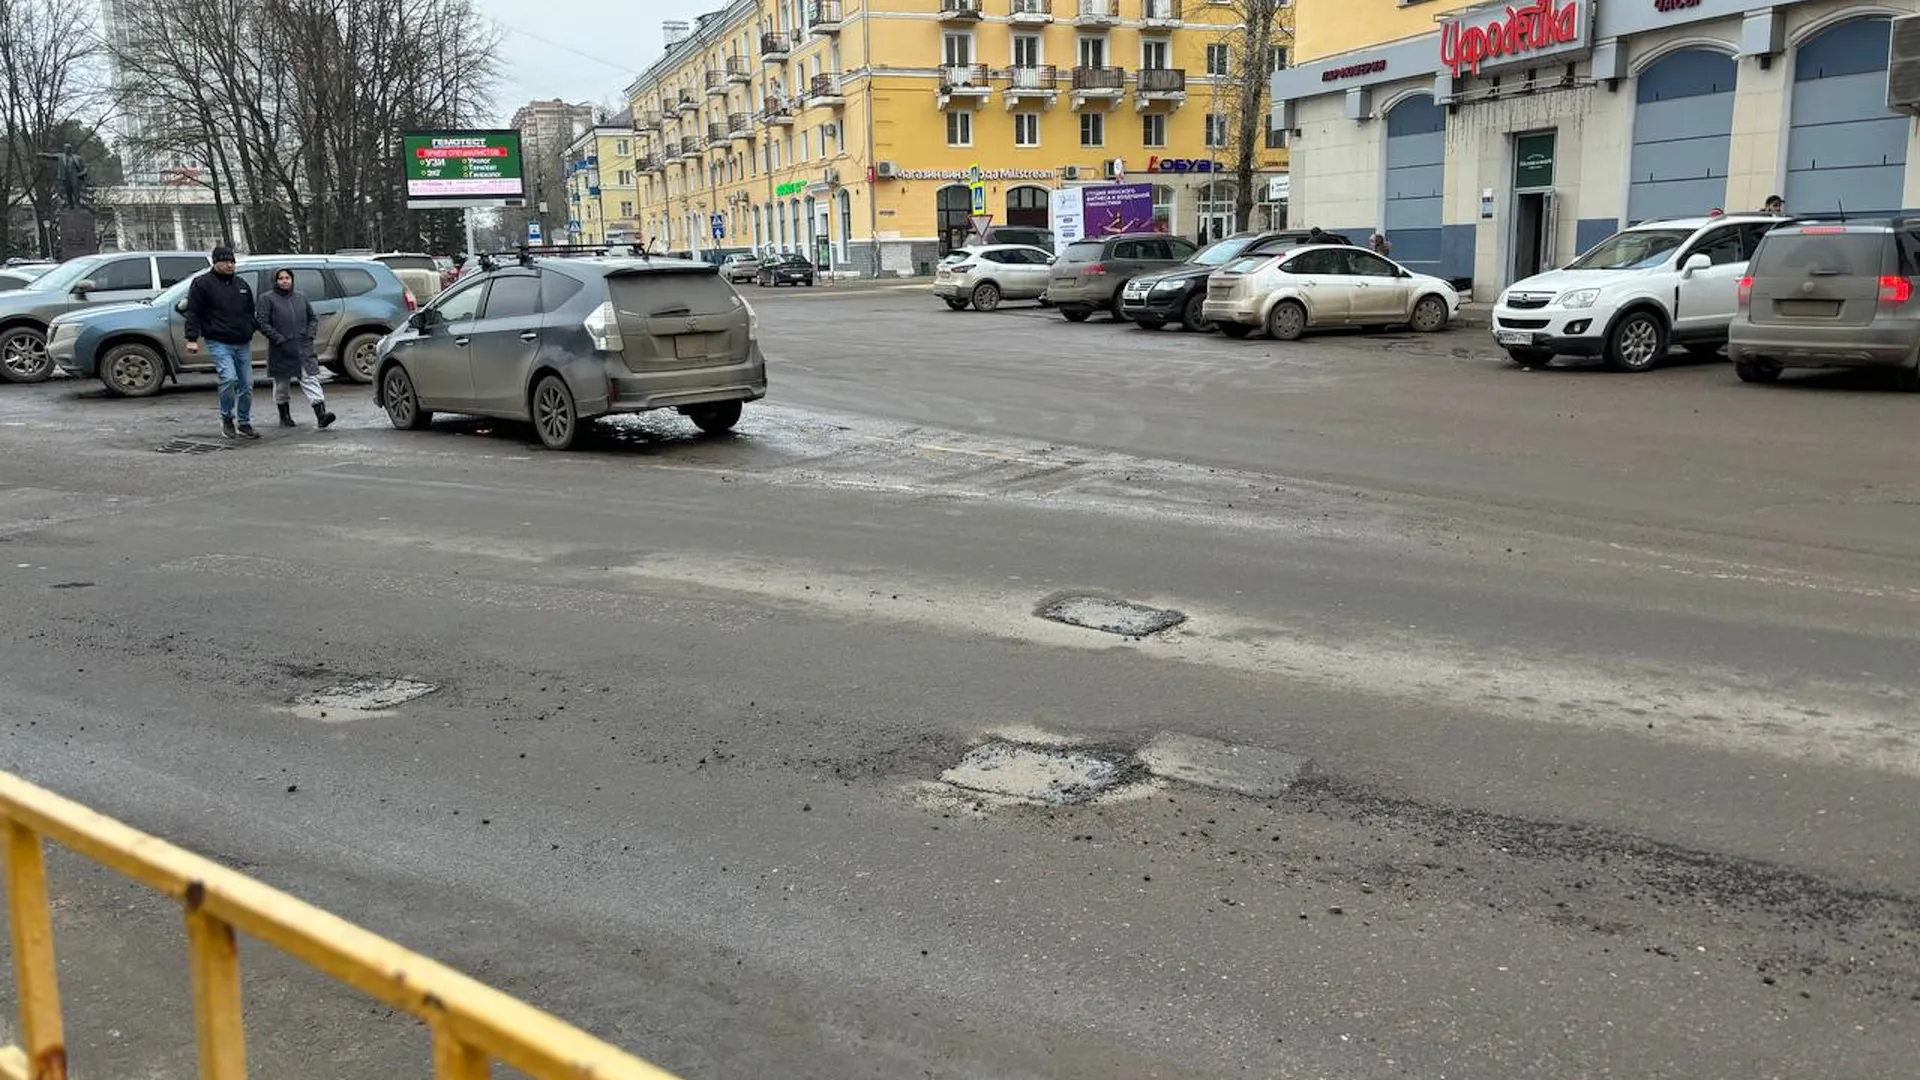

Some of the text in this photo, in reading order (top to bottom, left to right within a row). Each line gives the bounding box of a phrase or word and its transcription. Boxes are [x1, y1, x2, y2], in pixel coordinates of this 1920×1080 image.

[1322, 60, 1387, 82] ПАРФЮМЕРИЯ
[431, 138, 486, 147] ГЕМОТЕСТ
[425, 158, 446, 168] УЗИ
[1000, 168, 1056, 179] Millstream
